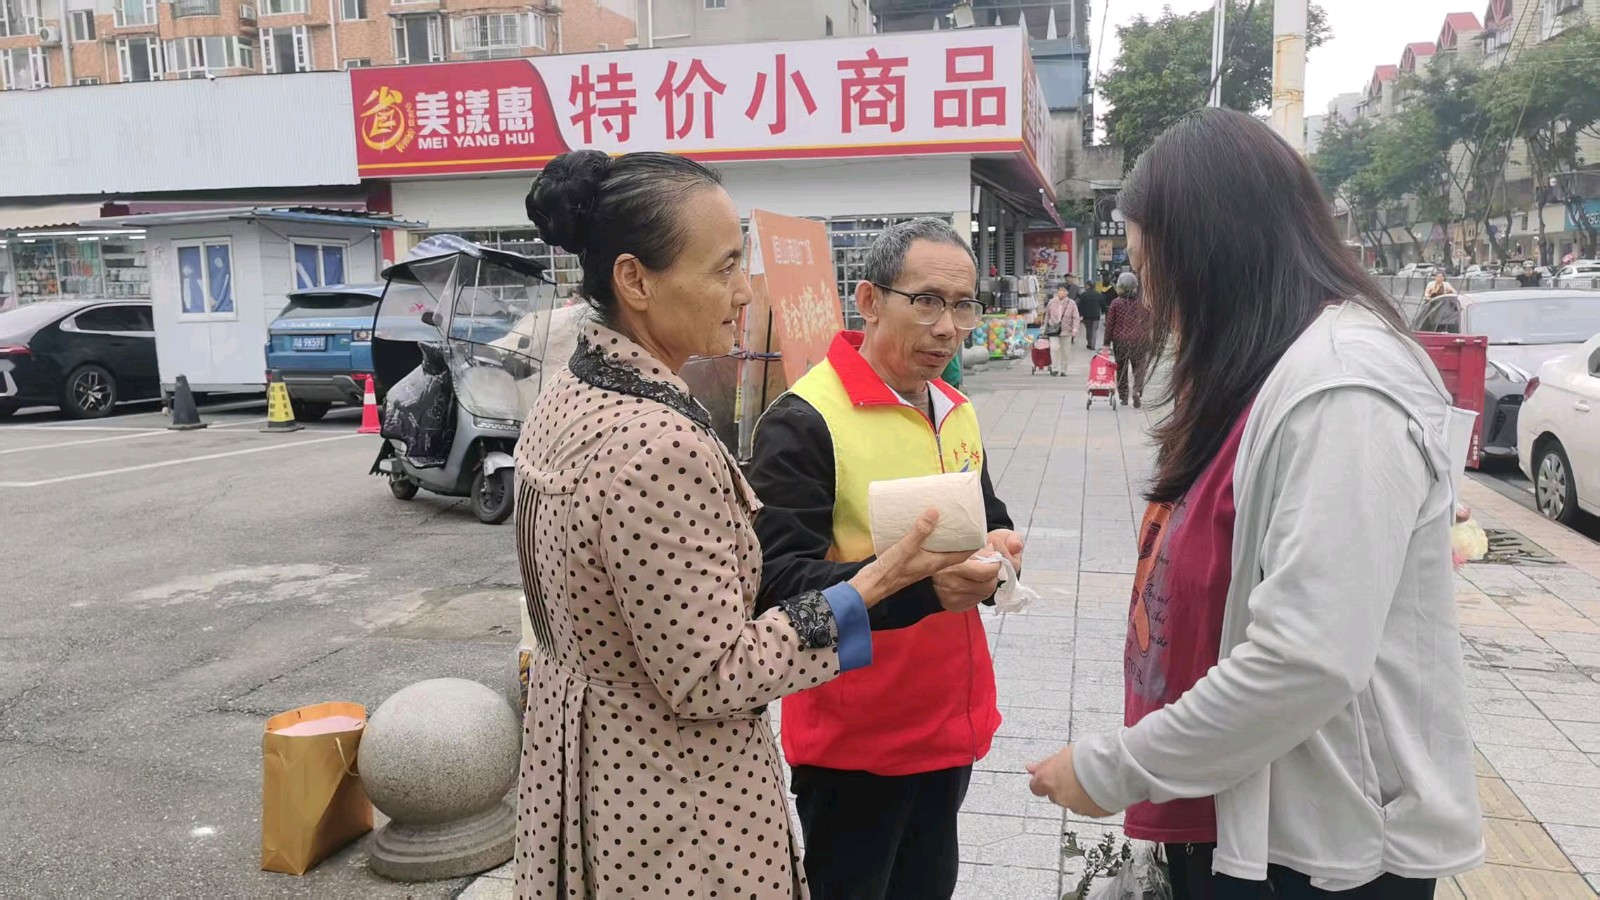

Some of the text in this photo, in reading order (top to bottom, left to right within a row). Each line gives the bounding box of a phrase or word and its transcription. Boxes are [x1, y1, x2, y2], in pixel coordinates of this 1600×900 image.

[415, 86, 535, 136] 美漾惠
[568, 45, 1007, 144] 特价小商品
[418, 132, 536, 150] MEI YANG HUI
